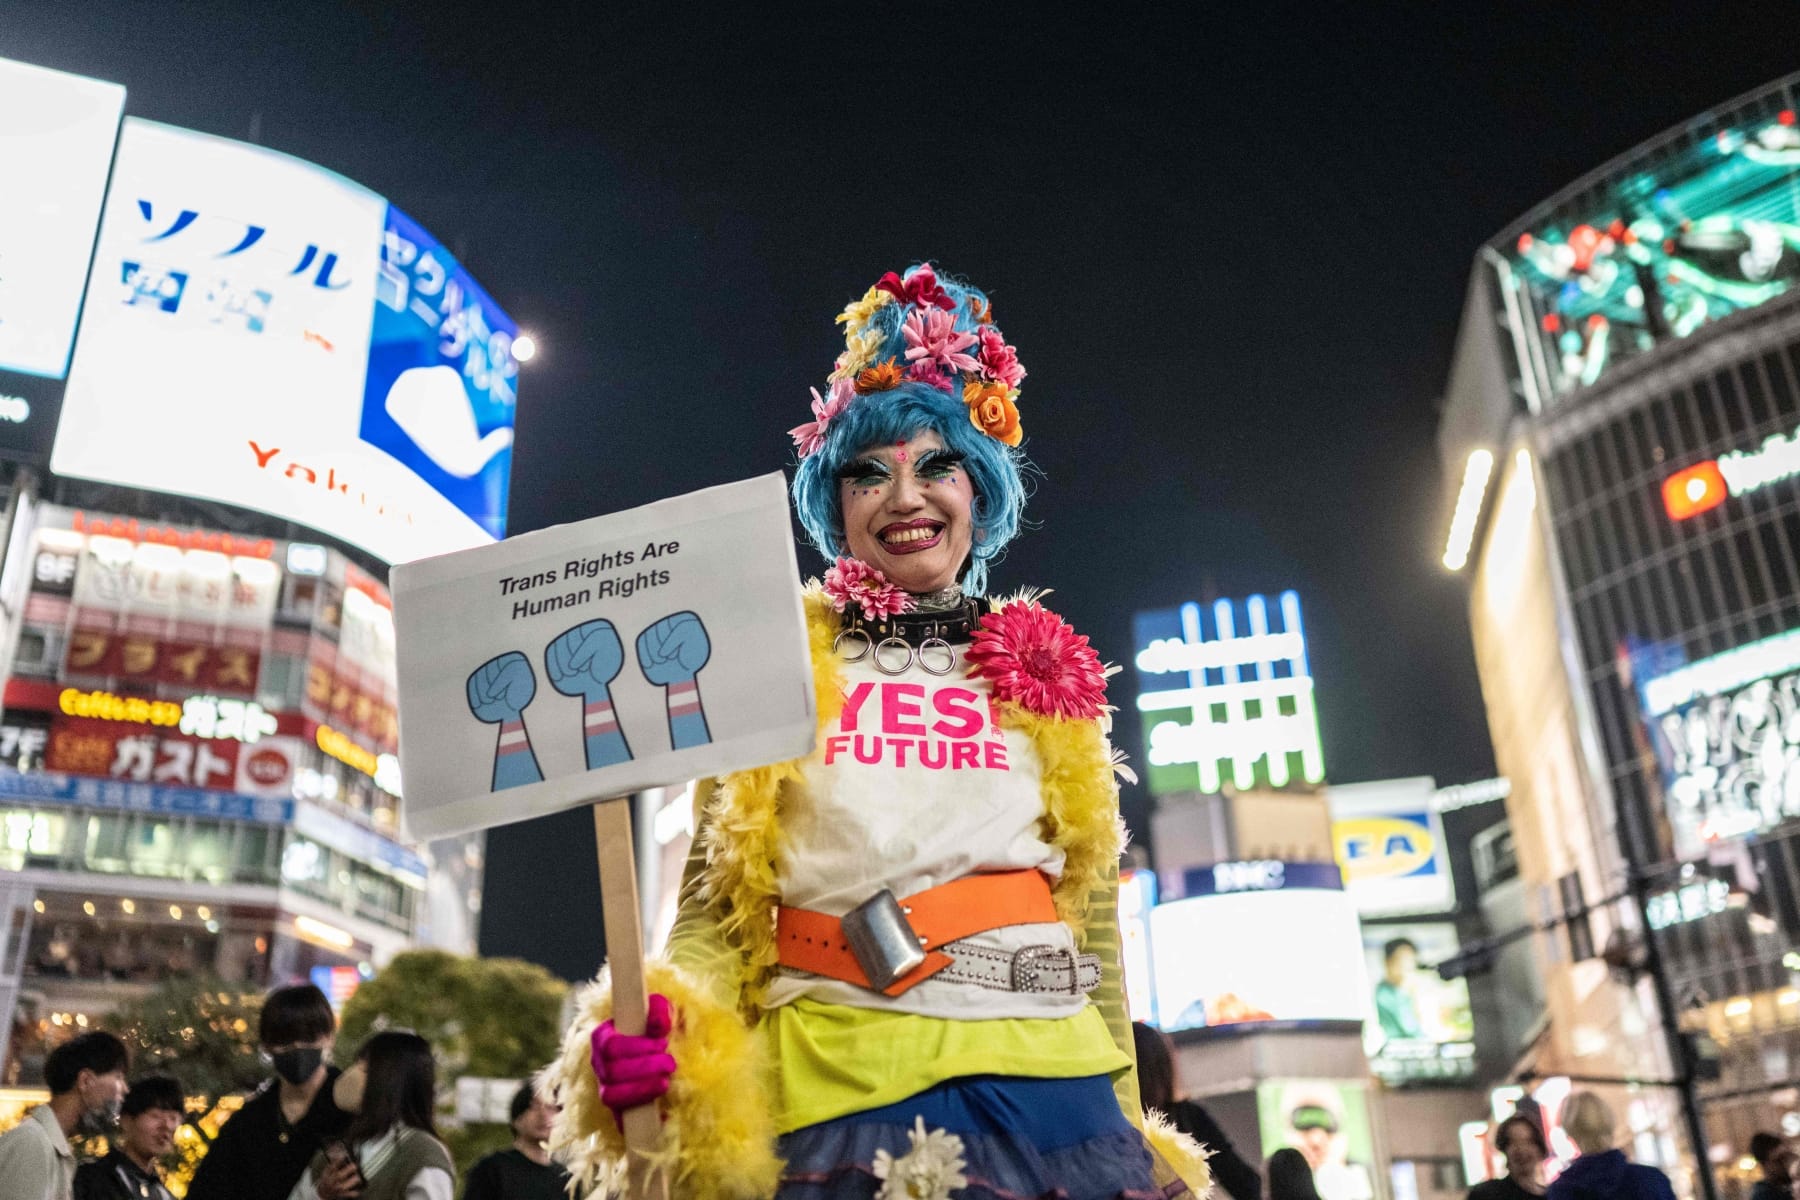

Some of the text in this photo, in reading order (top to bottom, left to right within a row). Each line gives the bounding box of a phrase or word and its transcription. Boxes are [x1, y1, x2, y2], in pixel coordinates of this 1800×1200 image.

[499, 541, 680, 596] Trans Rights Are
[511, 569, 670, 620] Human Rights
[110, 734, 231, 786] ガスト
[825, 734, 1010, 772] FUTURE
[1345, 834, 1416, 860] EA
